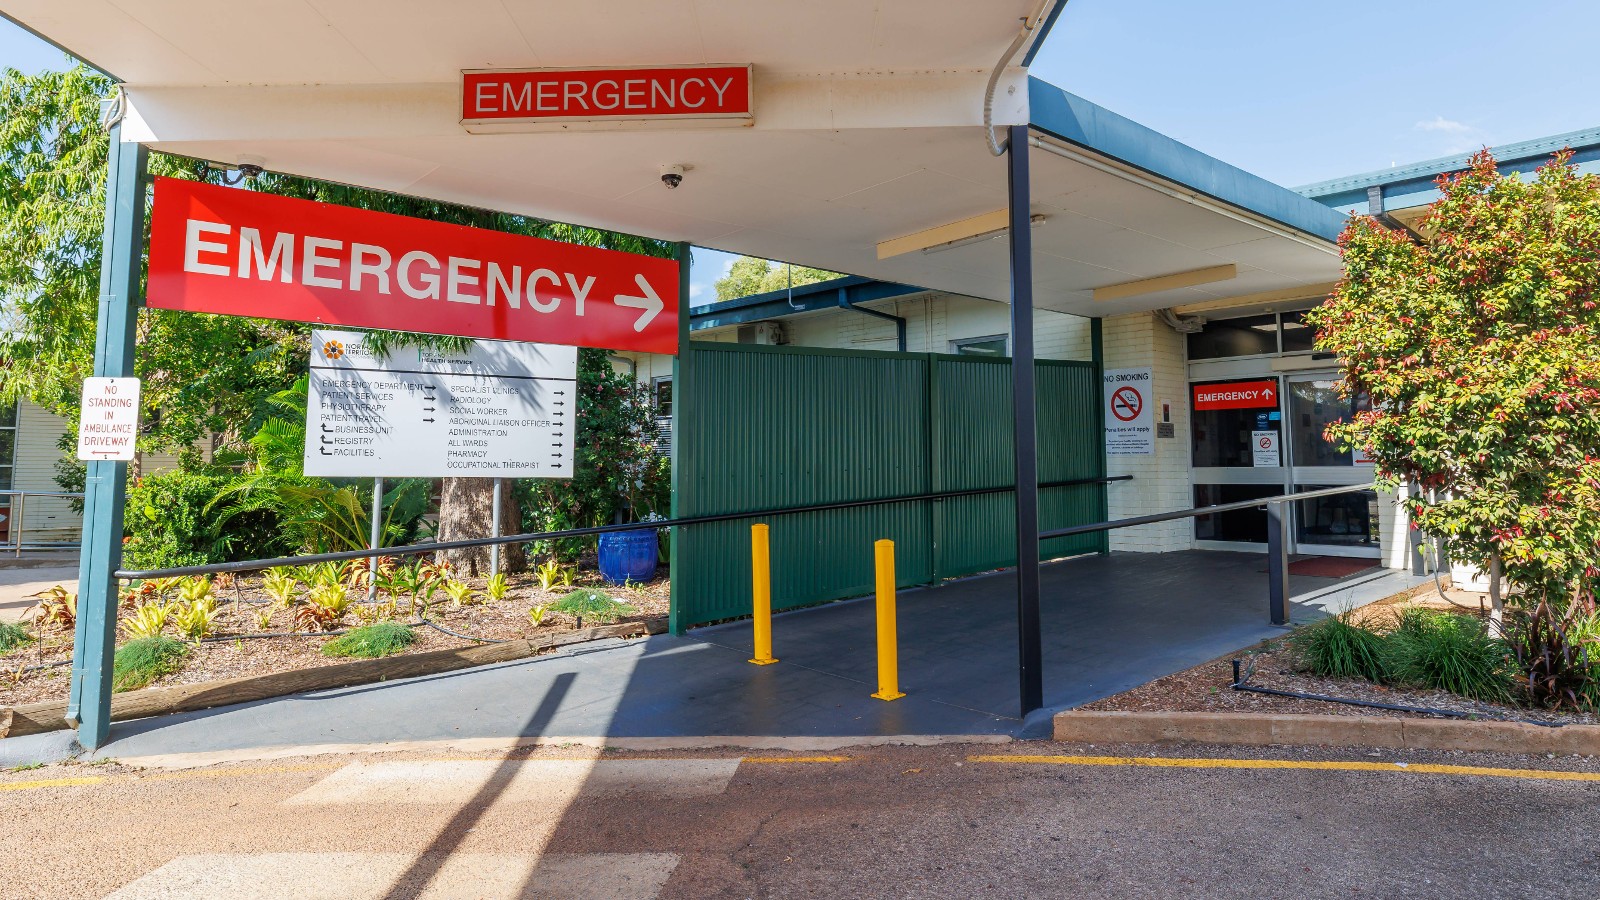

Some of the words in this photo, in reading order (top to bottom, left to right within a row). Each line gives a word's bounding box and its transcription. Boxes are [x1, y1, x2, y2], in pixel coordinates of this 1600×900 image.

[475, 77, 734, 113] EMERGENCY
[184, 218, 596, 317] EMERGENCY
[1116, 373, 1149, 381] SMOKING
[105, 386, 117, 394] NO
[322, 380, 372, 389] EMERGENCY
[374, 382, 424, 391] DEPARTMENT
[450, 386, 490, 394] SPECIALIST
[493, 387, 519, 395] CLINICS
[450, 396, 491, 404] RADIOLOGY
[1198, 391, 1258, 402] EMERGENCY
[88, 398, 132, 407] STANDING
[322, 403, 386, 411] PHYSIOTHERAPY
[105, 411, 114, 420] IN
[449, 418, 492, 426] ABORIGINAL
[84, 424, 132, 433] AMBULANCE
[84, 437, 129, 446] DRIVEWAY
